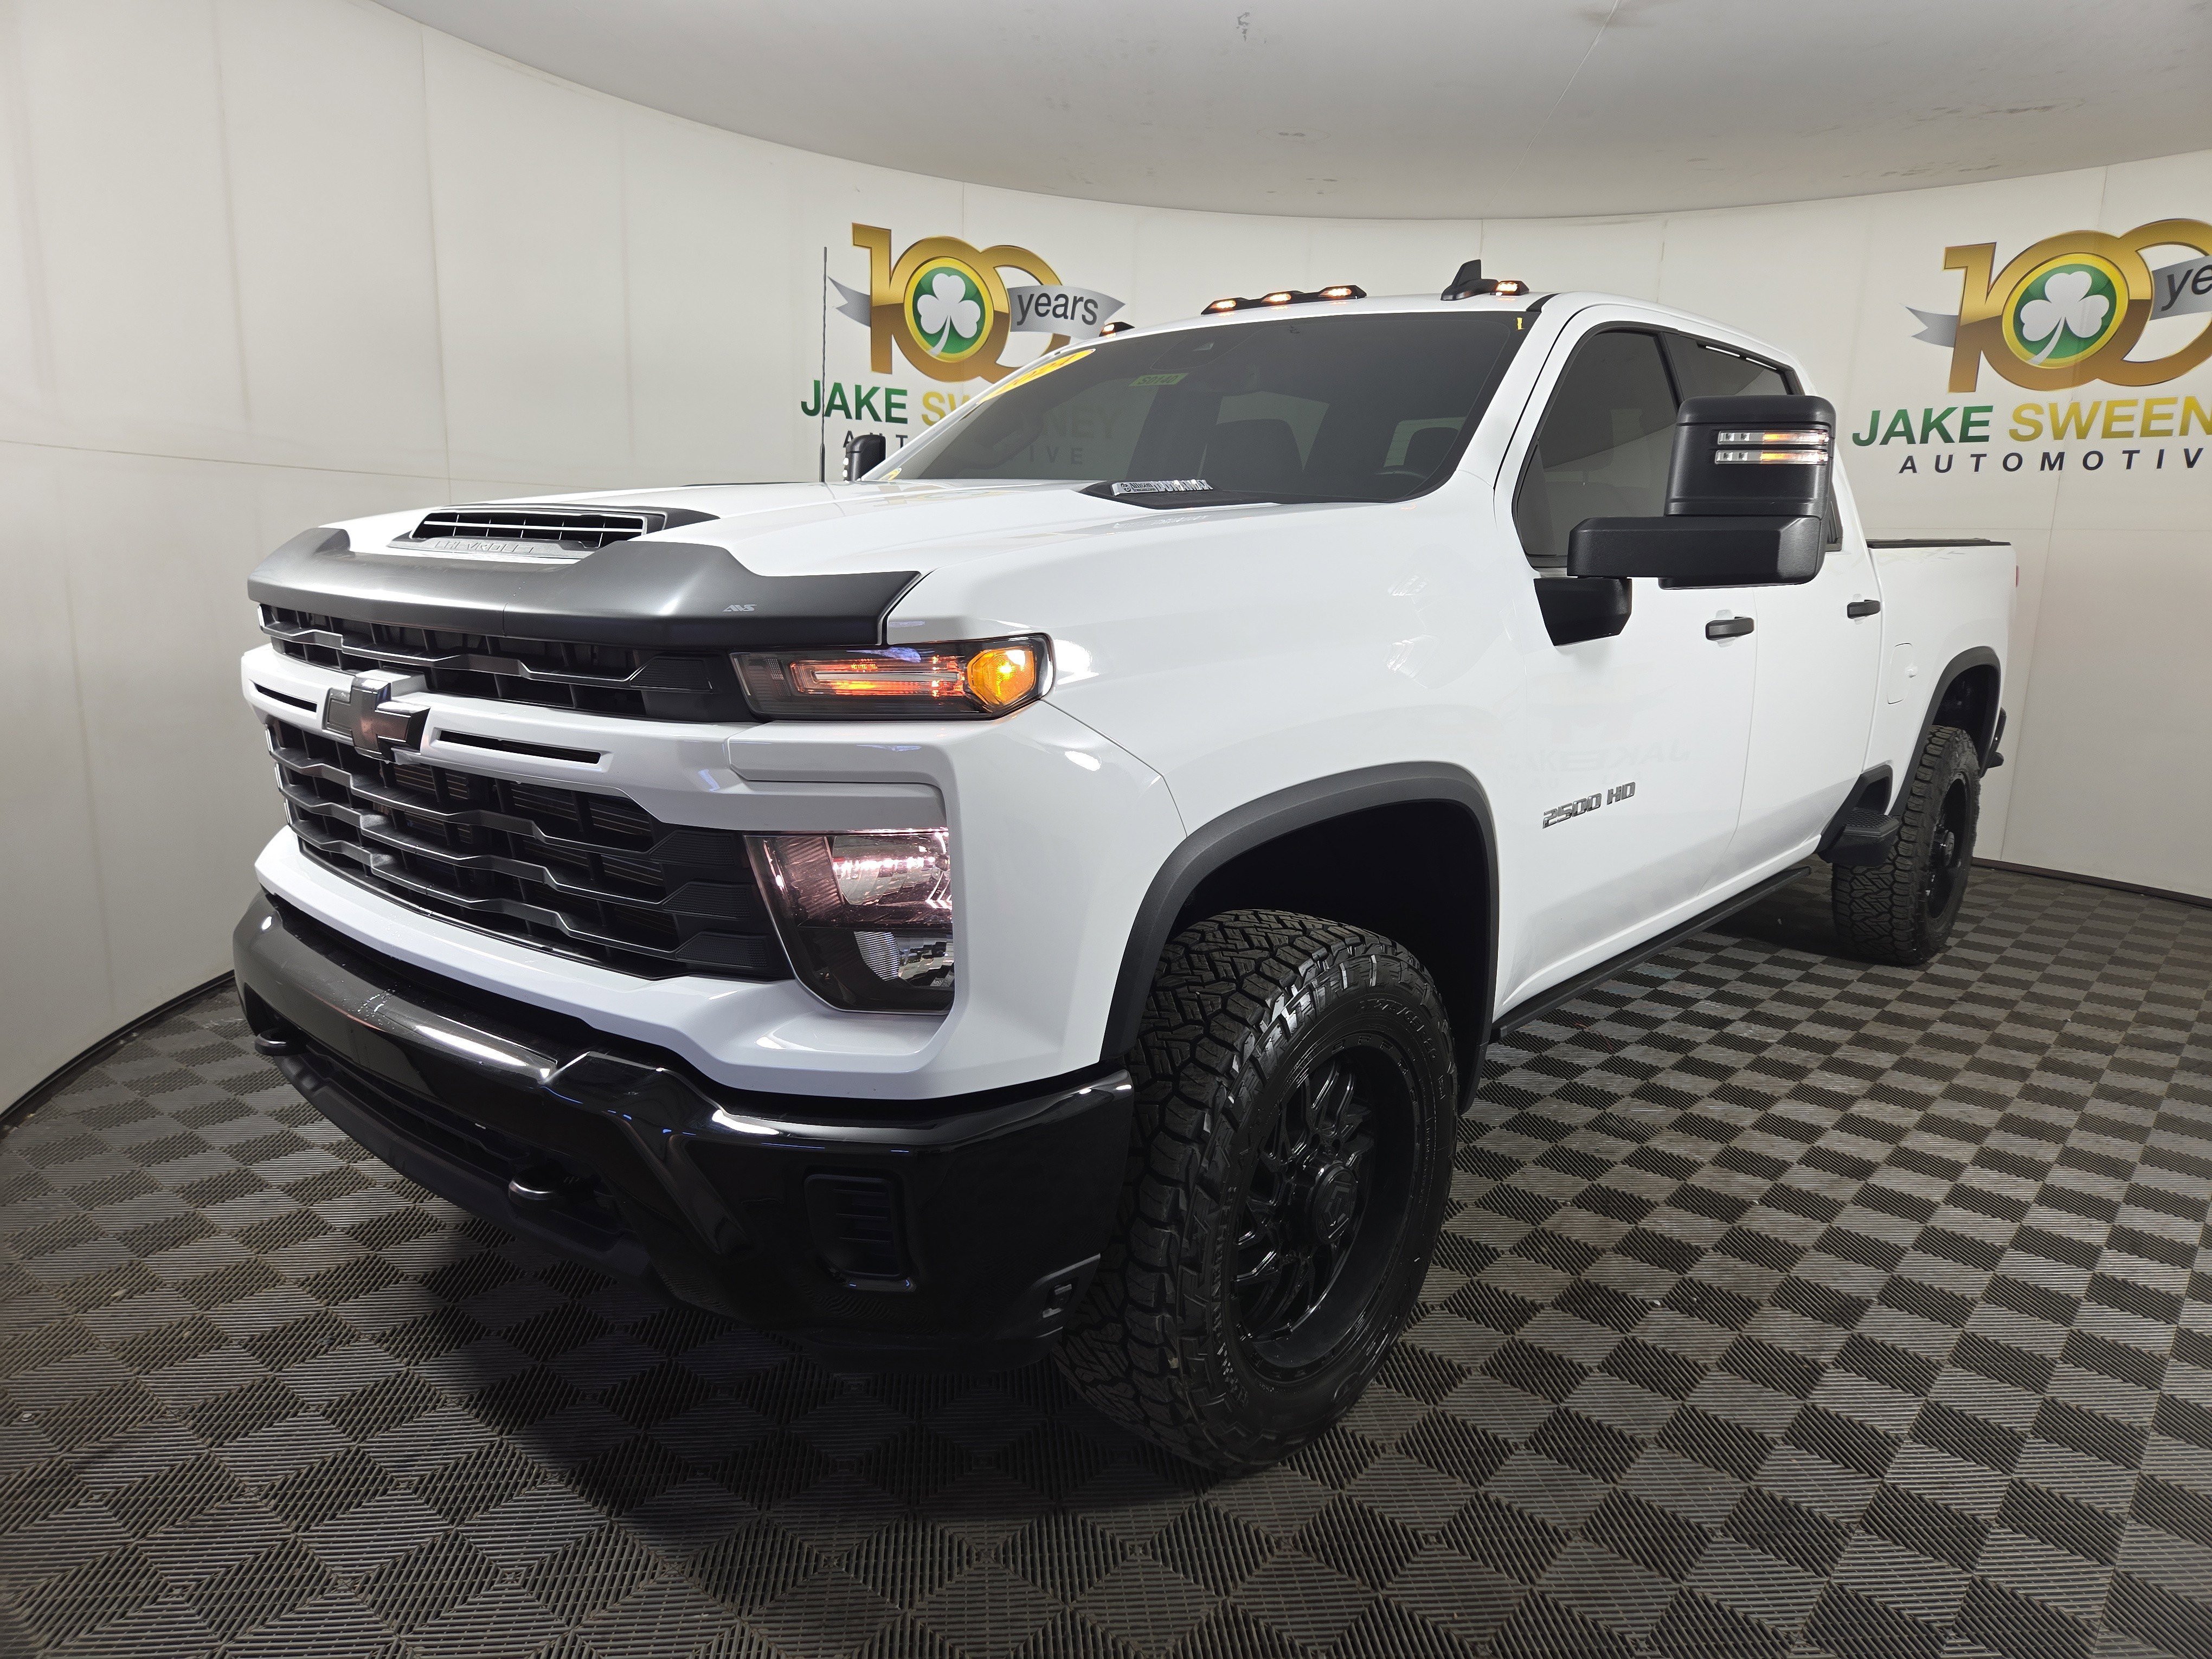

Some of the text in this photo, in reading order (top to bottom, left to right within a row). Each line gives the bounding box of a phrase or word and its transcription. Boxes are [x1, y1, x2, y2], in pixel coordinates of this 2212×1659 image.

[1017, 290, 1099, 326] years
[801, 380, 908, 424] JAKE
[1852, 406, 1993, 447] JAKE
[434, 540, 537, 553] CHEVROLET
[723, 604, 757, 612] AVS
[1542, 781, 1636, 829] 2500 HD
